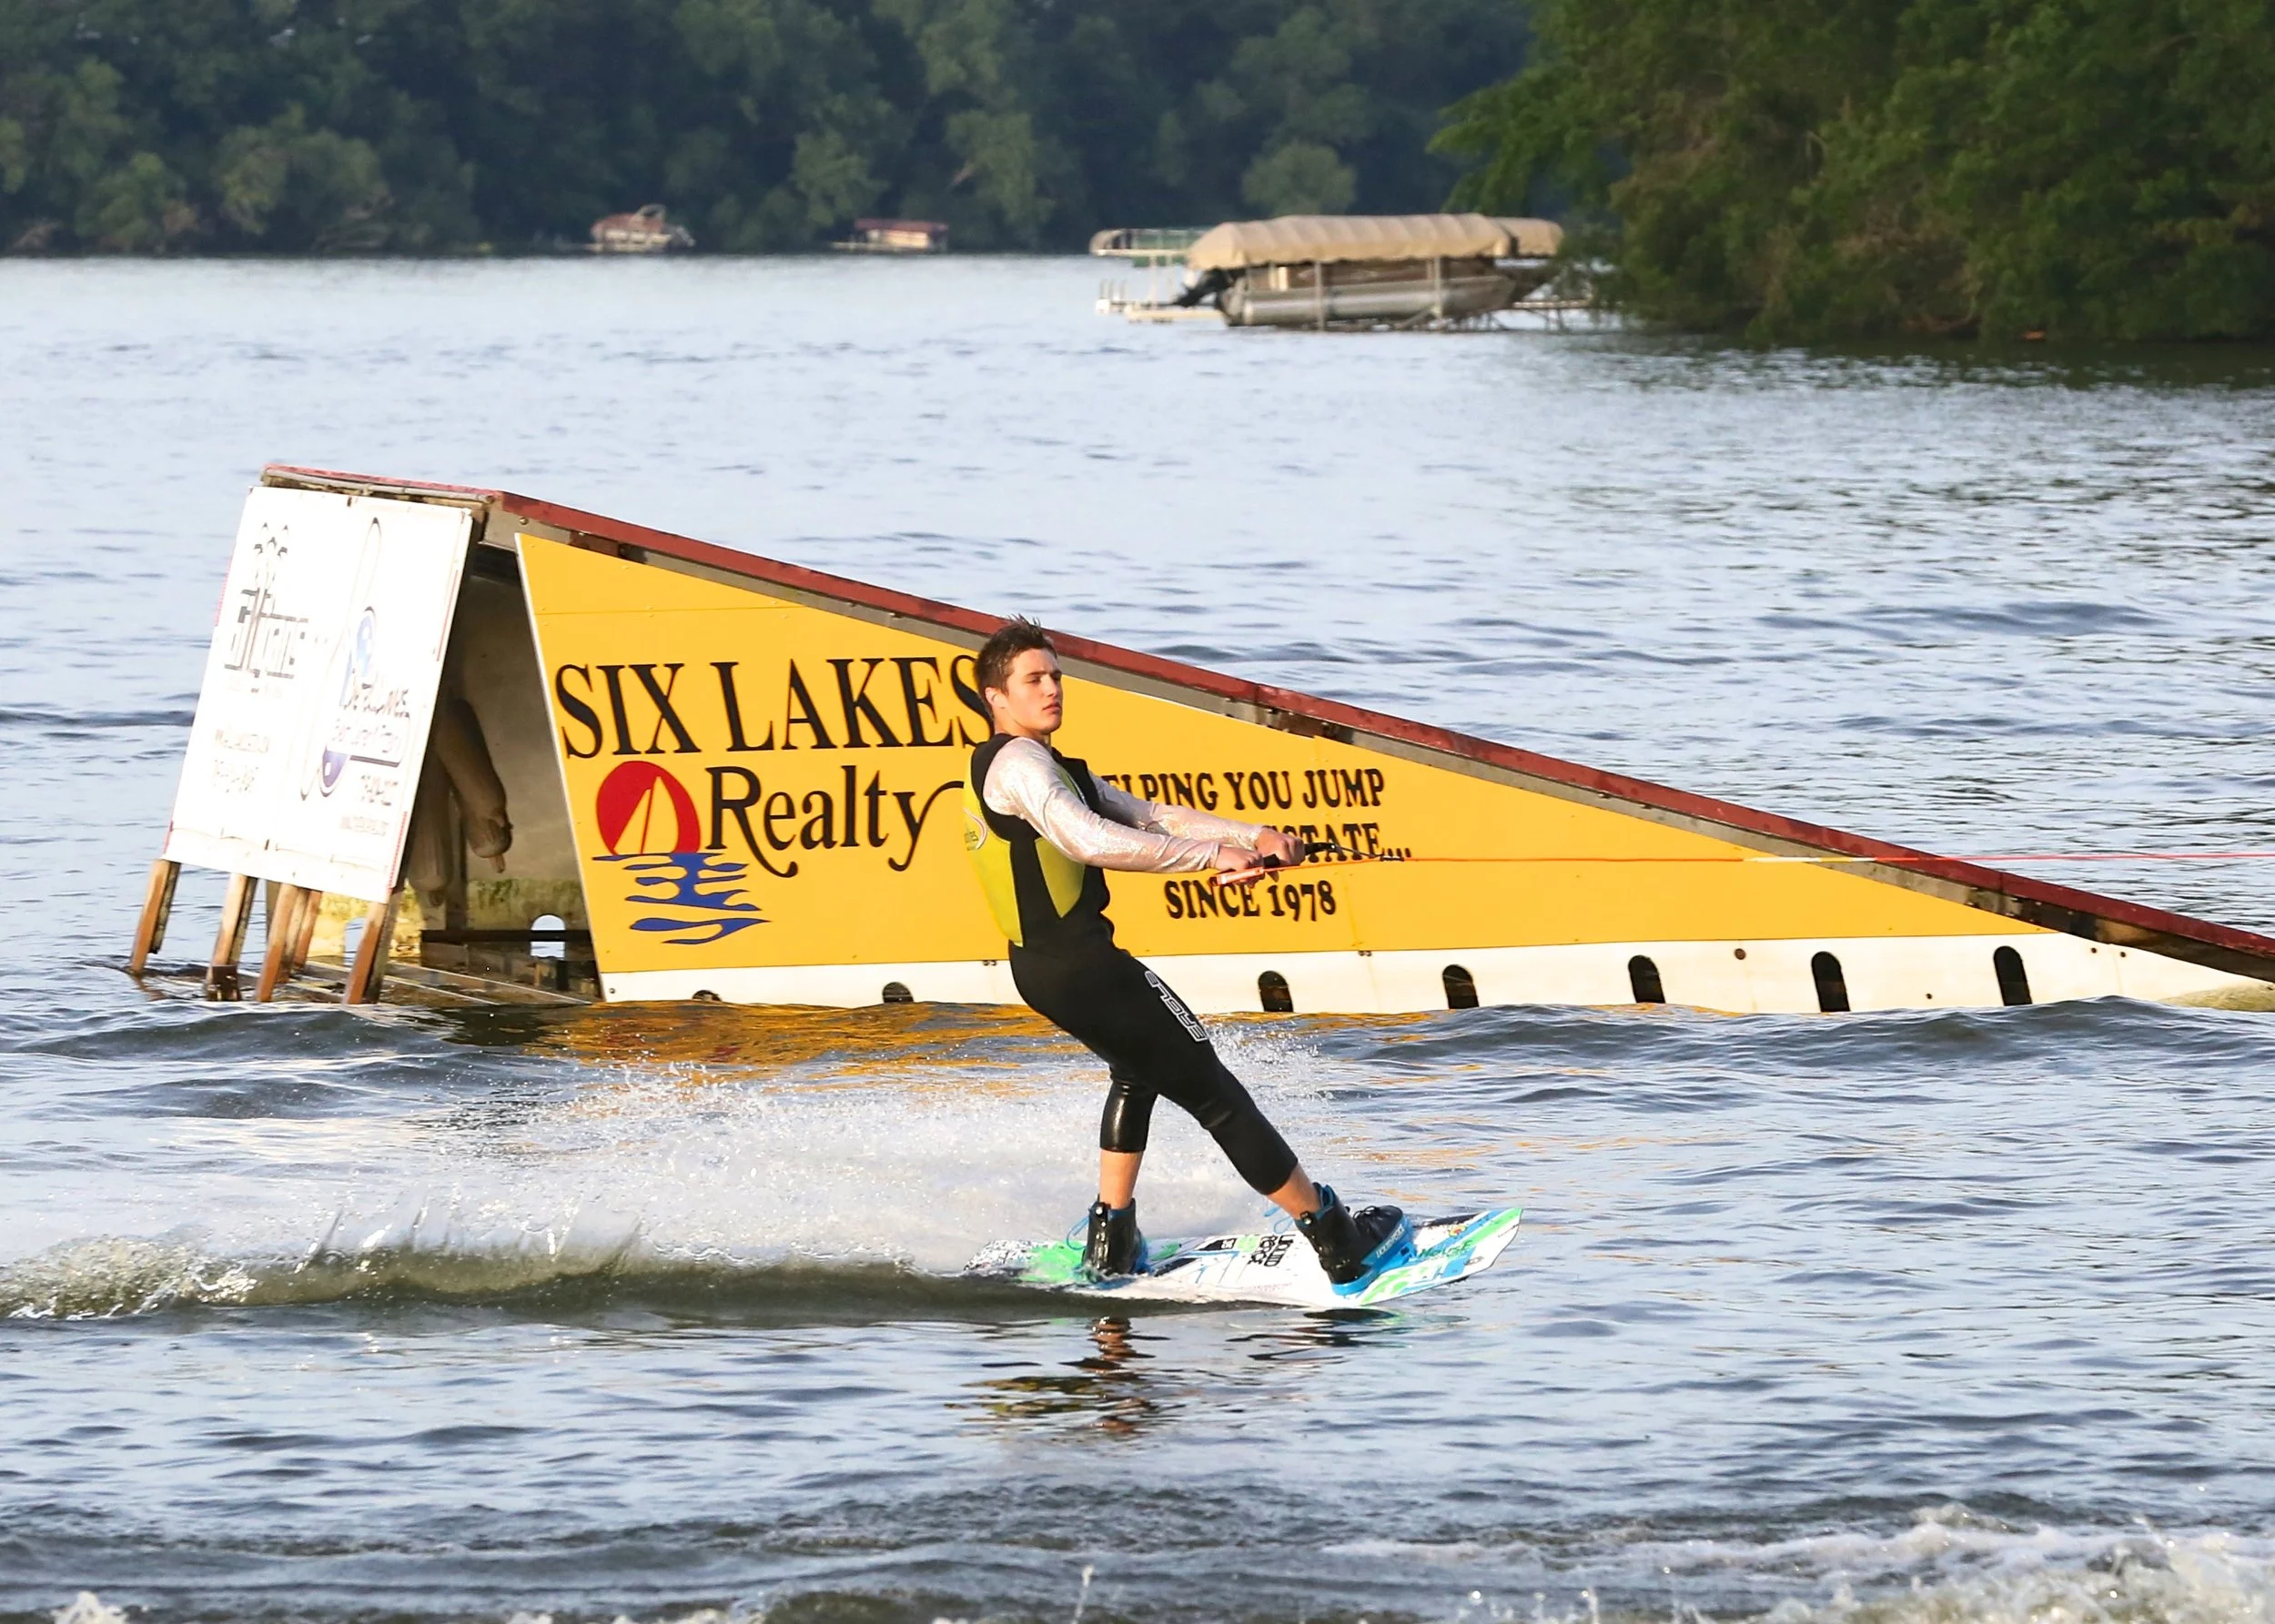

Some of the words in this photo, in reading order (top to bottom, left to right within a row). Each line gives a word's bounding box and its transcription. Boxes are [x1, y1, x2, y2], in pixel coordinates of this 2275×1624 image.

[556, 663, 702, 759] SIX
[710, 654, 996, 751] LAKES
[704, 764, 965, 879] Realty
[1223, 771, 1293, 811] YOU
[1302, 768, 1385, 809] JUMP
[1165, 879, 1260, 919] SINCE
[1267, 880, 1337, 922] 1978
